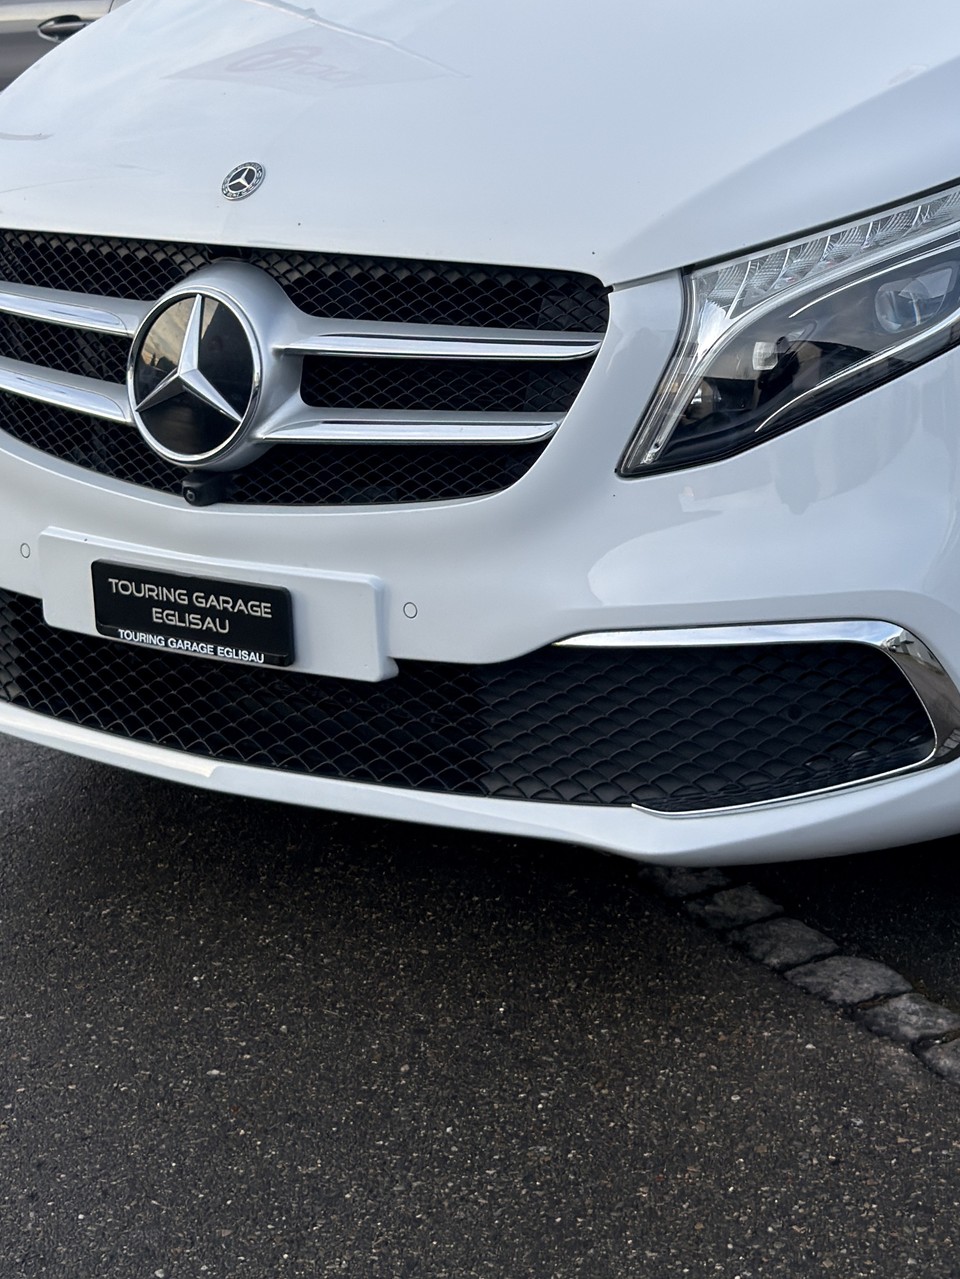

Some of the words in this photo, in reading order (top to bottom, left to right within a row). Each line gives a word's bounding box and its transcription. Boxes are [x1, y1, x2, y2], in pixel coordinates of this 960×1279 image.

[108, 578, 188, 605] TOURING
[193, 593, 272, 618] GARAGE
[152, 607, 230, 633] EGLISAU
[118, 629, 165, 647] TOURING
[167, 637, 214, 655] GARAGE
[217, 646, 265, 664] EGLISAU
